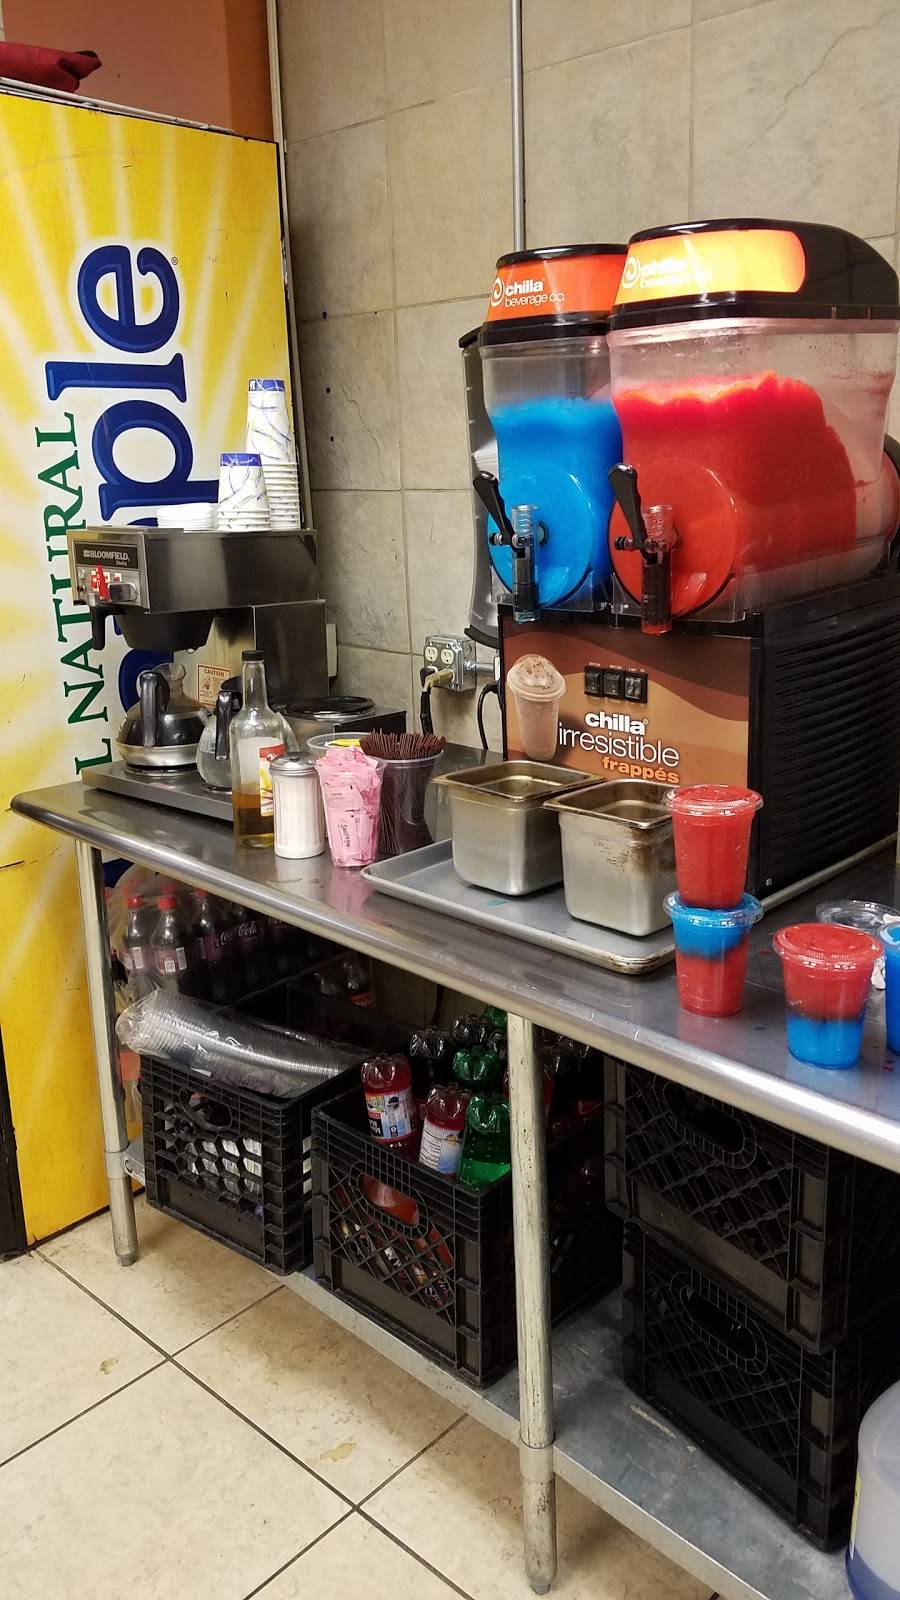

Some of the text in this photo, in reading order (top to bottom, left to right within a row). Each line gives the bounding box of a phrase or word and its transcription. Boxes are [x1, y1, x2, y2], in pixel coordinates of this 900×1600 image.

[505, 279, 544, 297] chilla
[505, 292, 566, 308] beverage co.
[90, 550, 129, 560] BLOOMFIELD
[204, 668, 226, 678] CAUTION
[559, 721, 680, 767] irresistible
[602, 756, 680, 784] frappés
